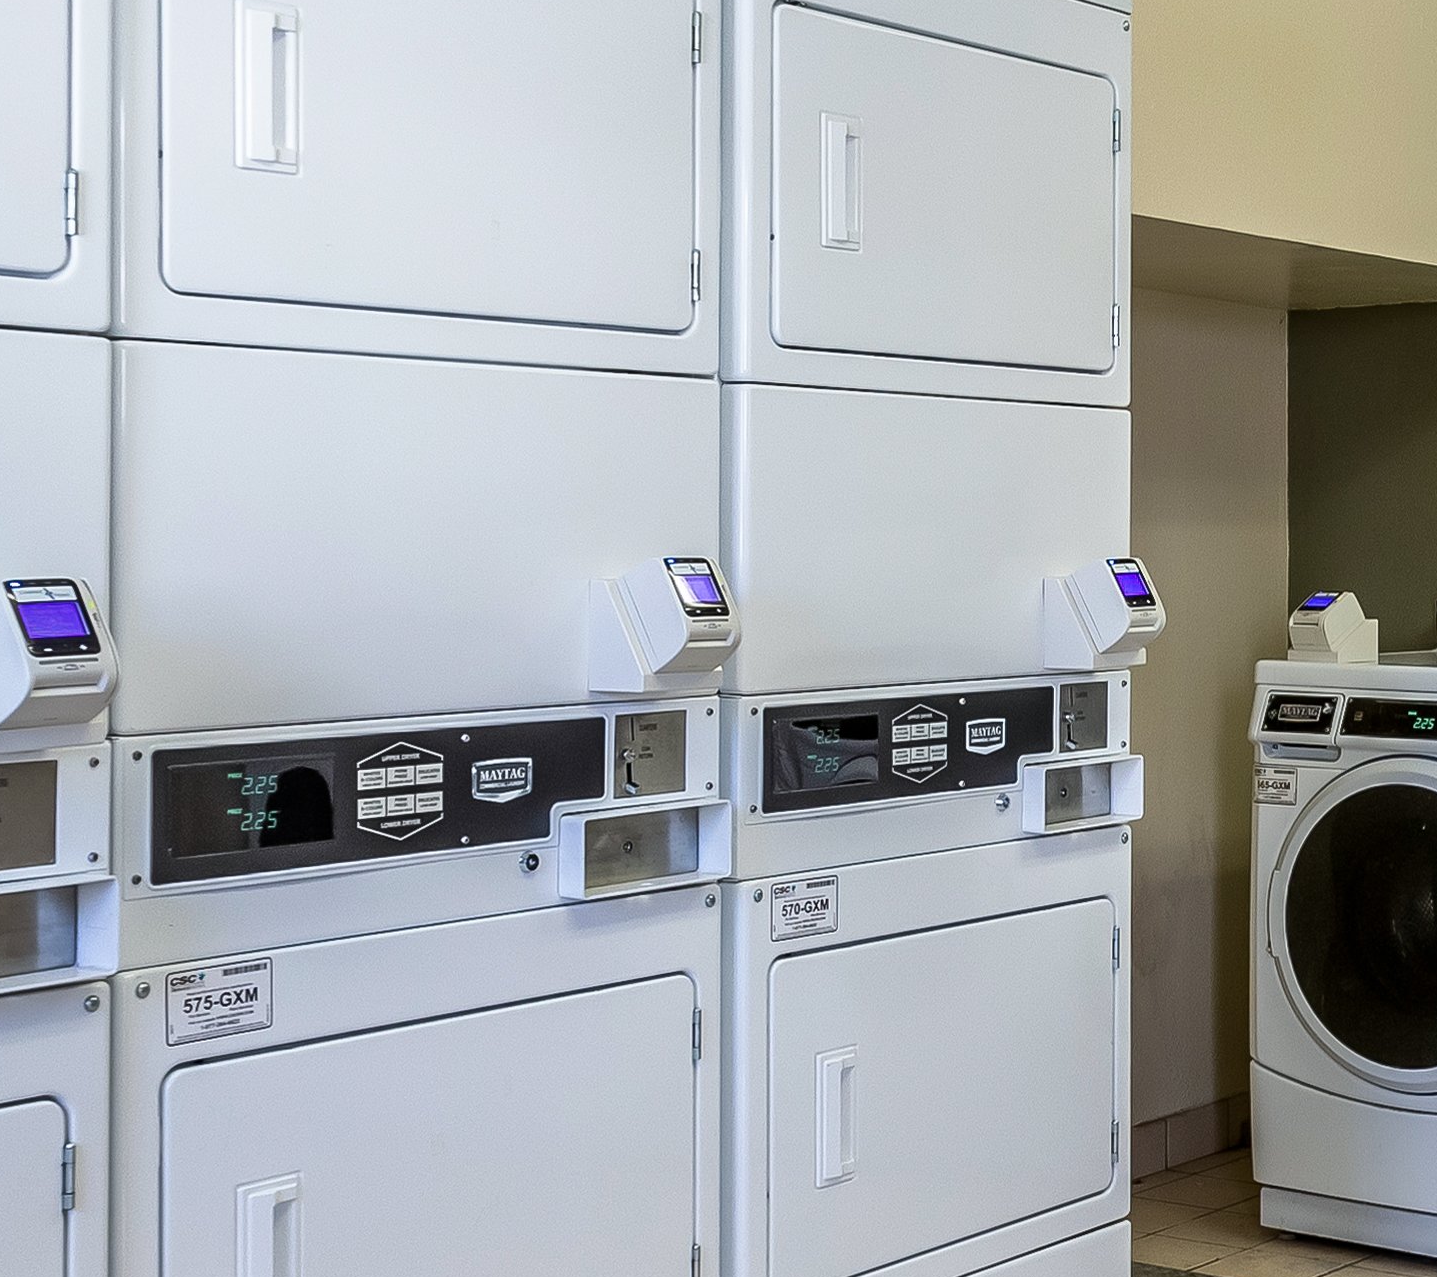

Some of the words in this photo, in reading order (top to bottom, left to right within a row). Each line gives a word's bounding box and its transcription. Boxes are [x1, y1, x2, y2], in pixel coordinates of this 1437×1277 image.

[1281, 706, 1319, 717] MAYTAG
[970, 725, 1002, 738] MAYTAG
[1413, 717, 1435, 730] 2.25
[816, 728, 840, 744] 2.25
[815, 756, 840, 773] 2.25
[479, 767, 526, 782] MAYTAG
[241, 775, 278, 795] 2.25
[240, 810, 279, 831] 2.25
[781, 898, 829, 917] 570-GXM
[183, 986, 259, 1014] 575-GXM
